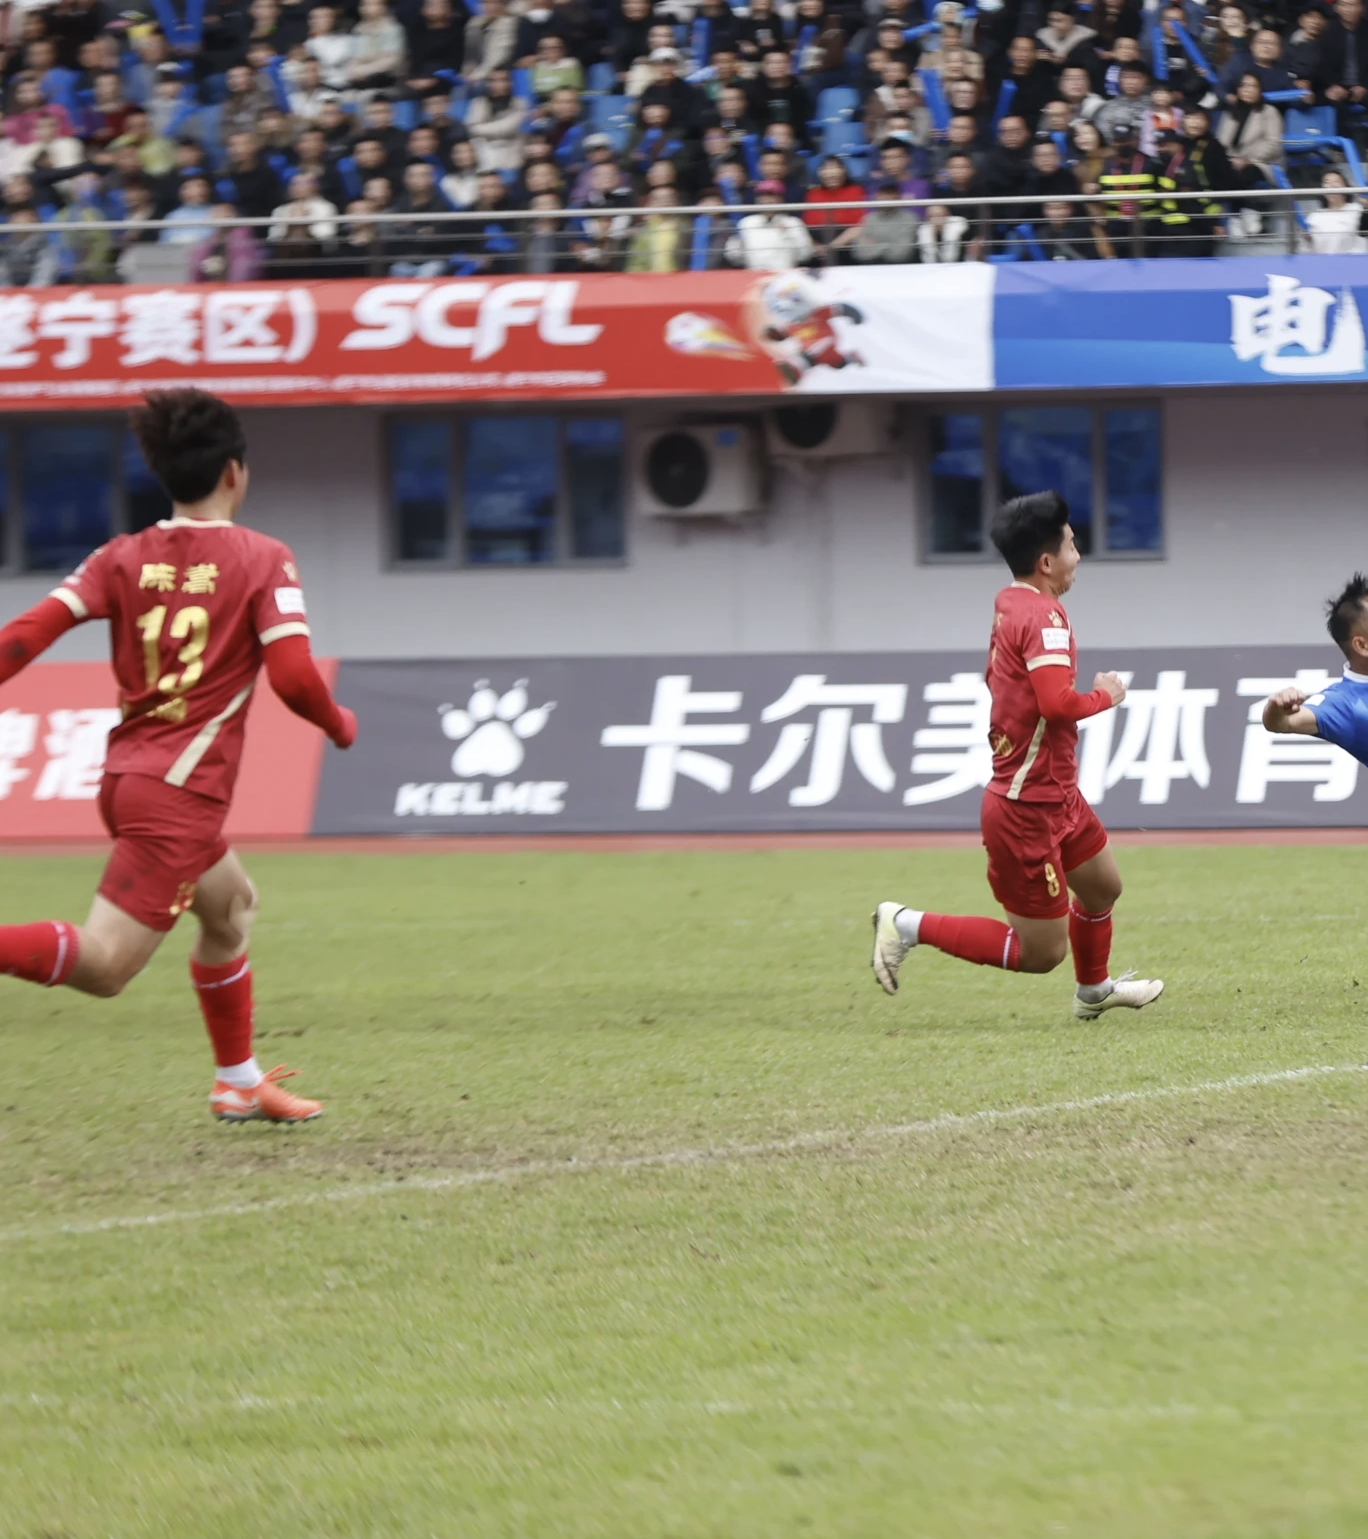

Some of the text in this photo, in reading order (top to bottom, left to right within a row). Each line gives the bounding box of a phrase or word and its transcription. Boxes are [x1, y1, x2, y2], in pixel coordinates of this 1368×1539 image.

[338, 280, 605, 362] SCFL
[136, 605, 209, 695] 13
[600, 668, 1358, 810] 卡尔美体育
[395, 782, 568, 816] KELME
[1044, 862, 1060, 897] 8
